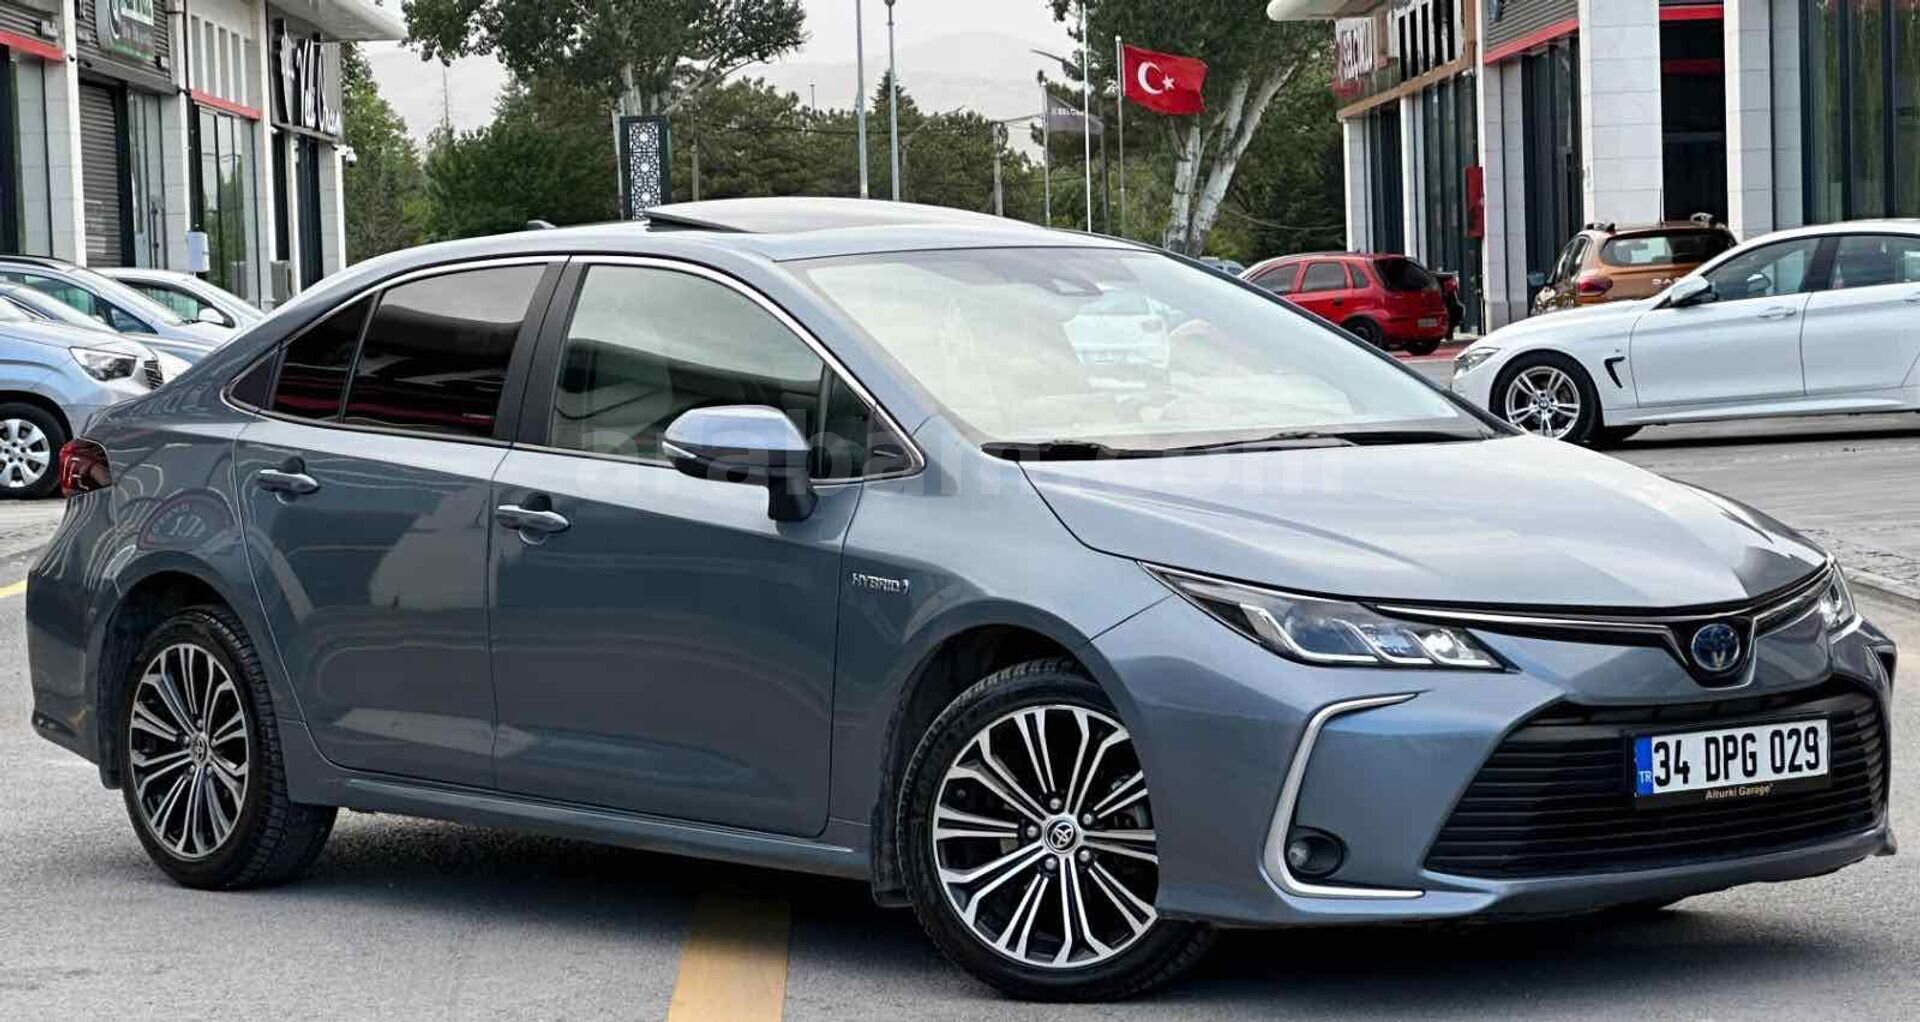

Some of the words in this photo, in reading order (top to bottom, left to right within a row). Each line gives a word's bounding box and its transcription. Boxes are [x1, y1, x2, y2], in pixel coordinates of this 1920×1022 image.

[852, 572, 900, 592] HYBRID
[1653, 739, 1690, 787] 34
[1705, 732, 1757, 782] DPG
[1769, 726, 1820, 774] 029
[1639, 770, 1653, 784] TR
